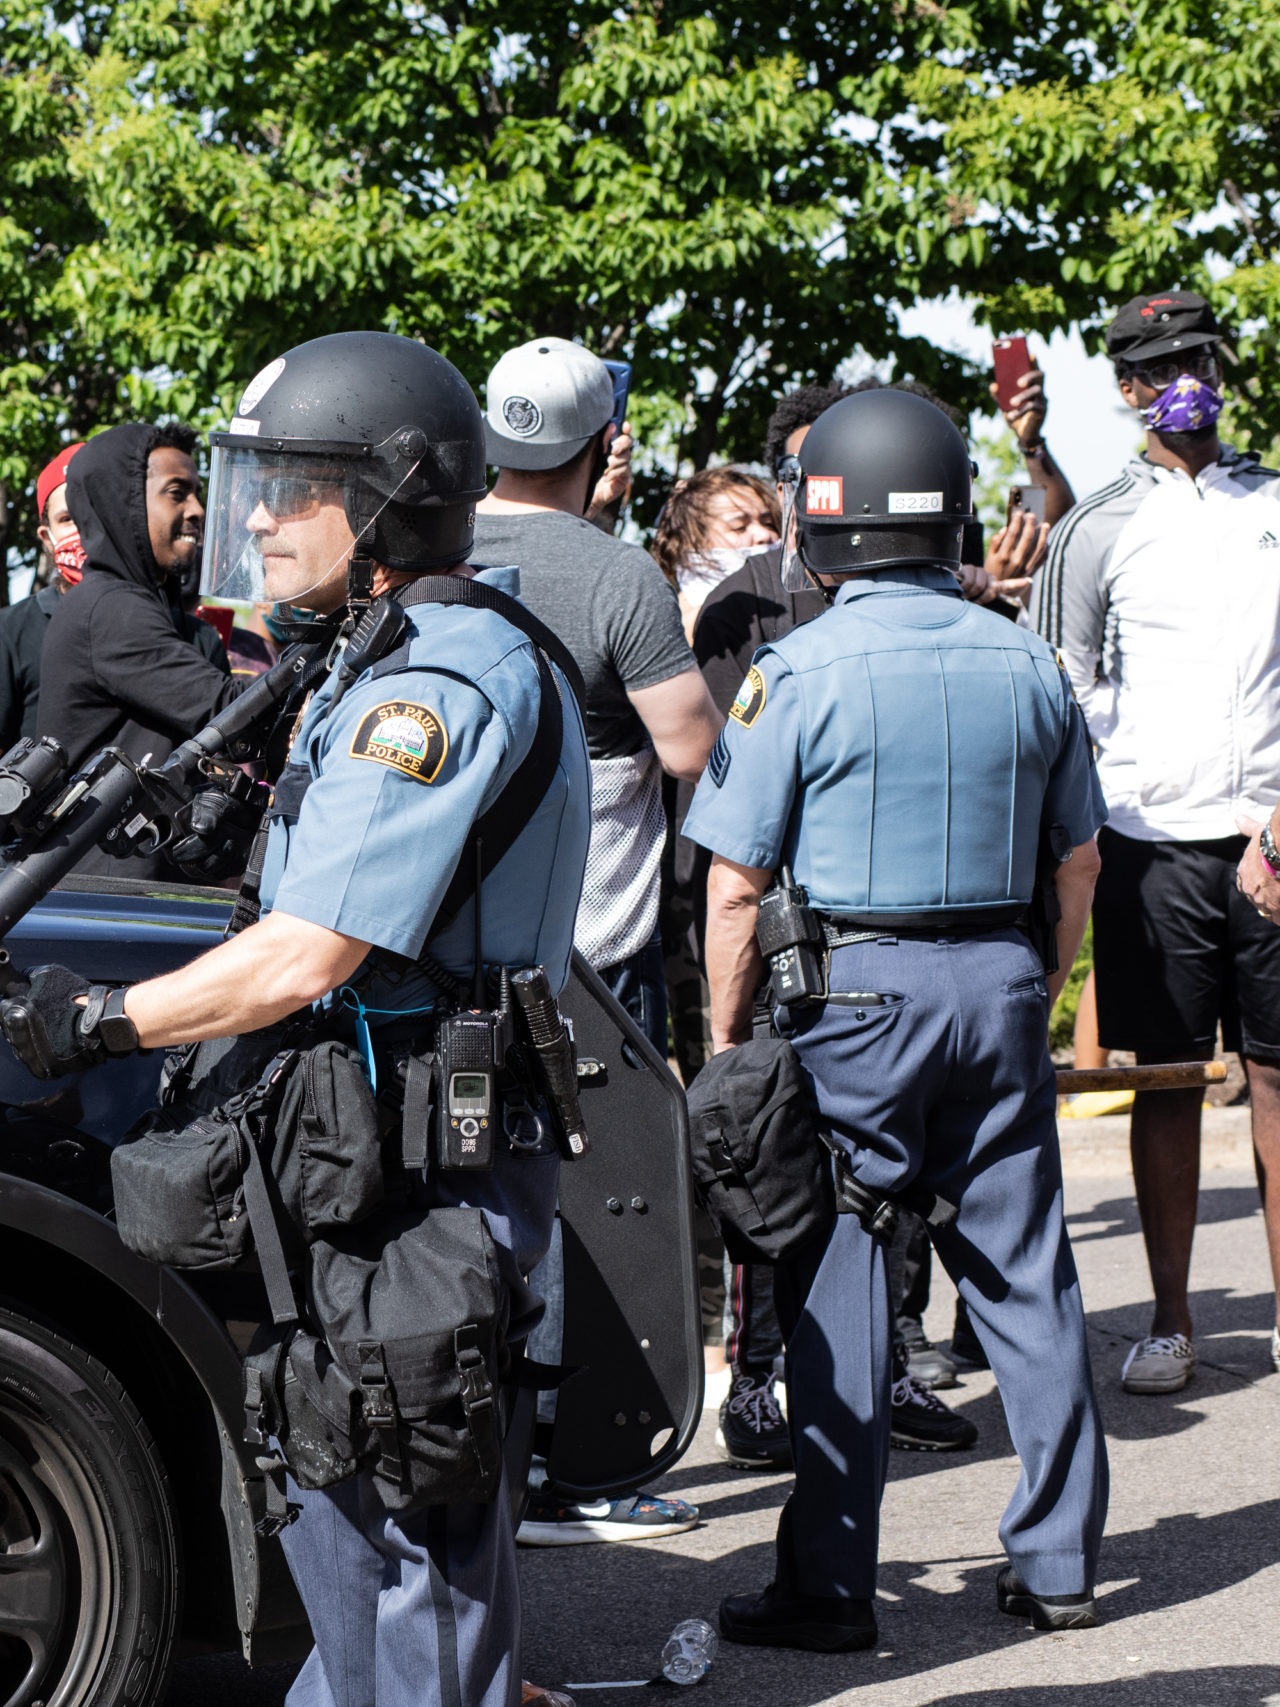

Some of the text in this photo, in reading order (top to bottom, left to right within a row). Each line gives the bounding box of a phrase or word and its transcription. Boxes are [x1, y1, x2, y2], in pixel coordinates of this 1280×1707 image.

[807, 479, 840, 511] SPPD
[377, 705, 438, 738] ST. PAUL
[363, 743, 422, 772] POLICE
